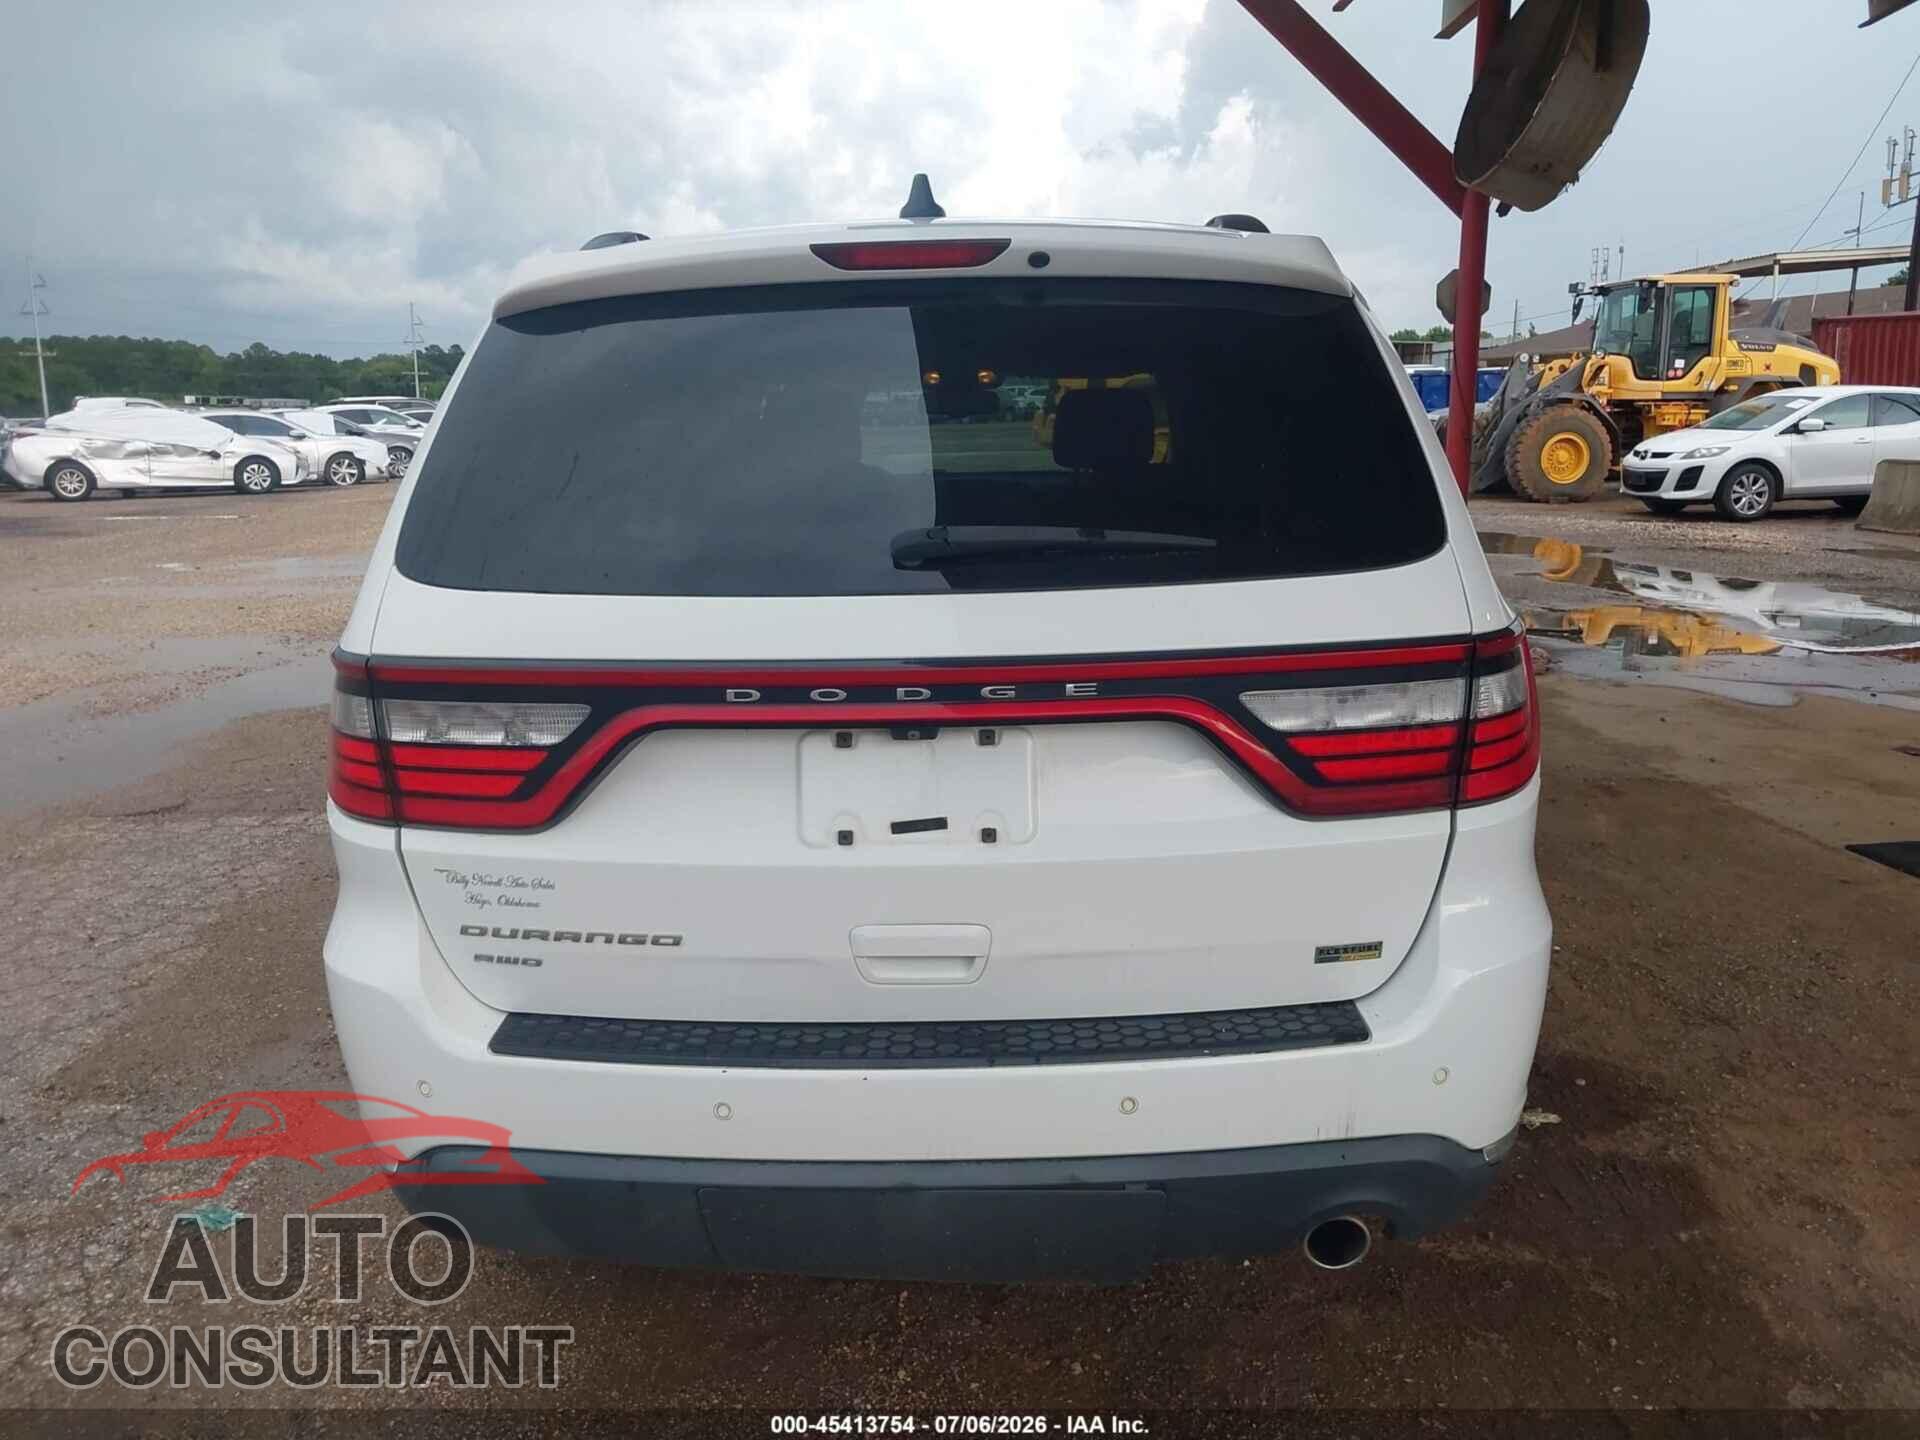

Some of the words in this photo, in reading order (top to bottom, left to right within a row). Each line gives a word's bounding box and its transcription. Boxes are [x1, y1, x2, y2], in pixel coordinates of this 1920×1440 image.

[1740, 342, 1775, 352] VOLVO
[725, 682, 1099, 702] DODGE
[531, 876, 556, 890] Sales
[497, 894, 543, 908] Oklahoma
[459, 924, 684, 947] DURANGO
[473, 953, 544, 968] AWD
